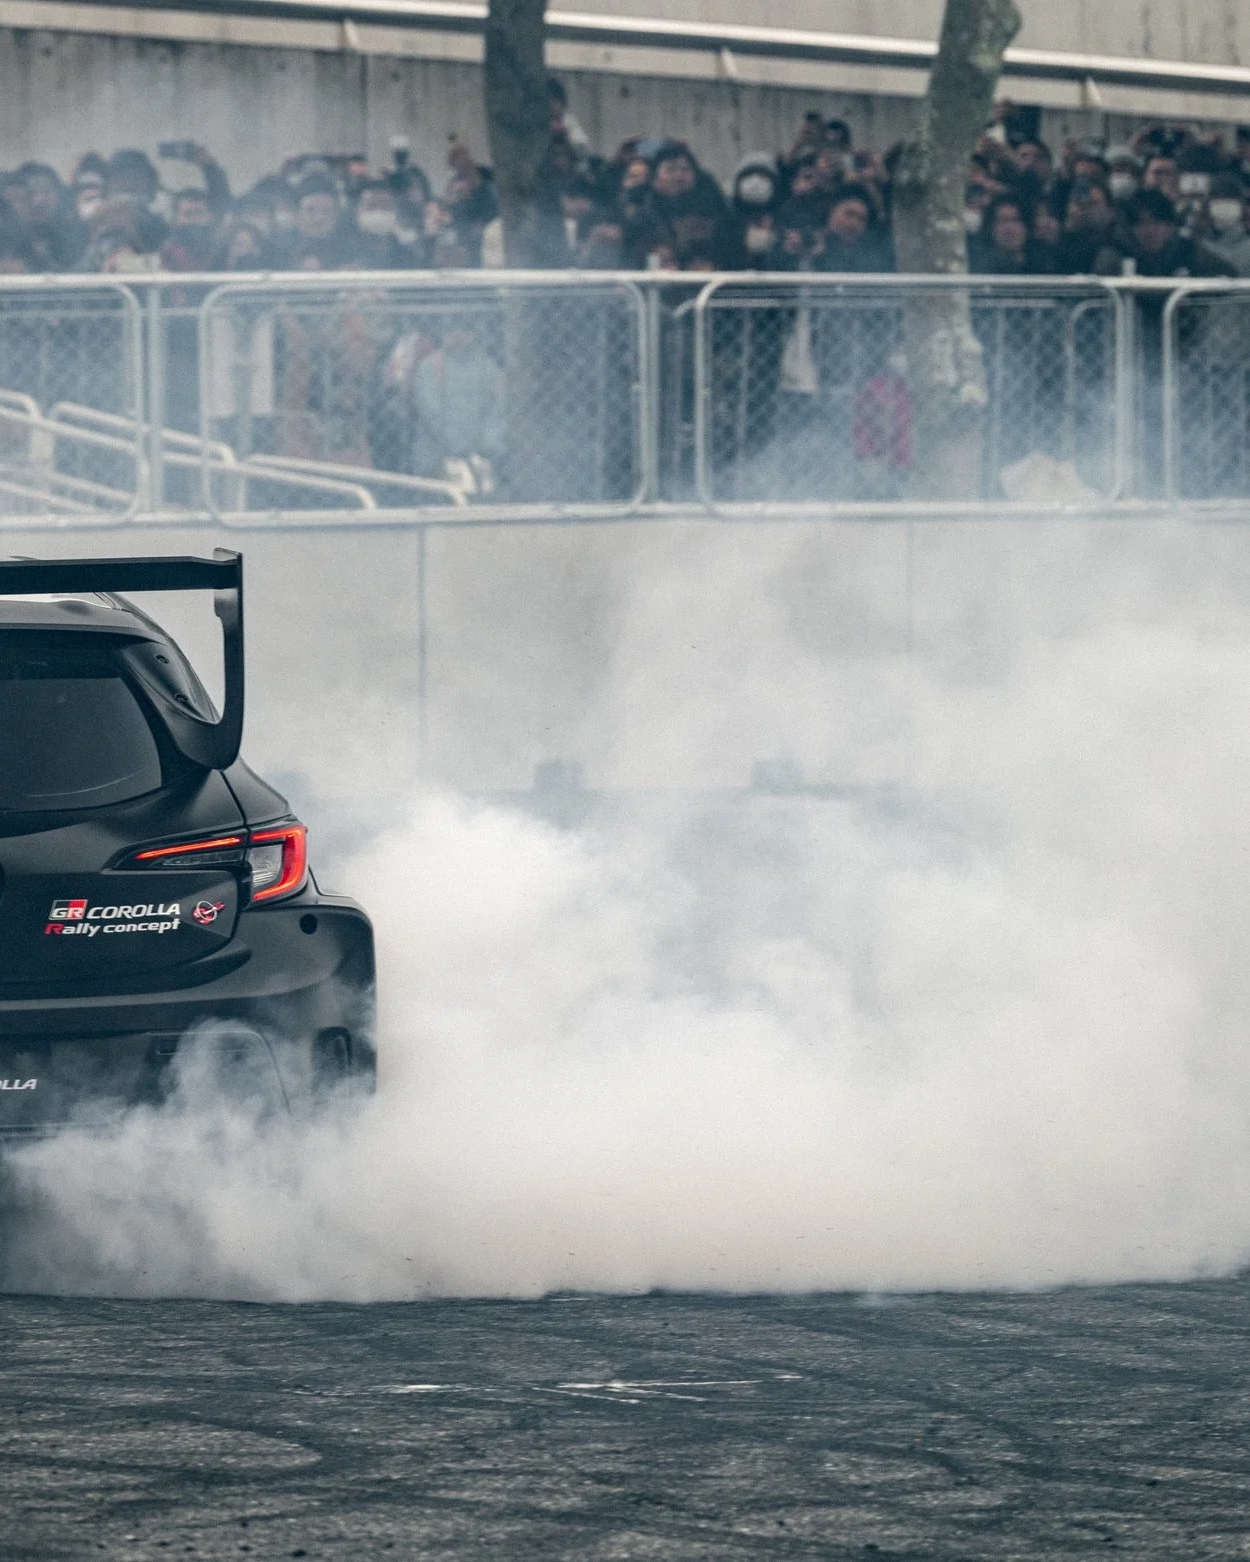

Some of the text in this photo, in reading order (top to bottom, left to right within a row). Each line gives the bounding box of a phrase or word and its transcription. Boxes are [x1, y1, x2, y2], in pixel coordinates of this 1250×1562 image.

[50, 903, 180, 919] GR COROLLA
[44, 918, 180, 937] Rally concept
